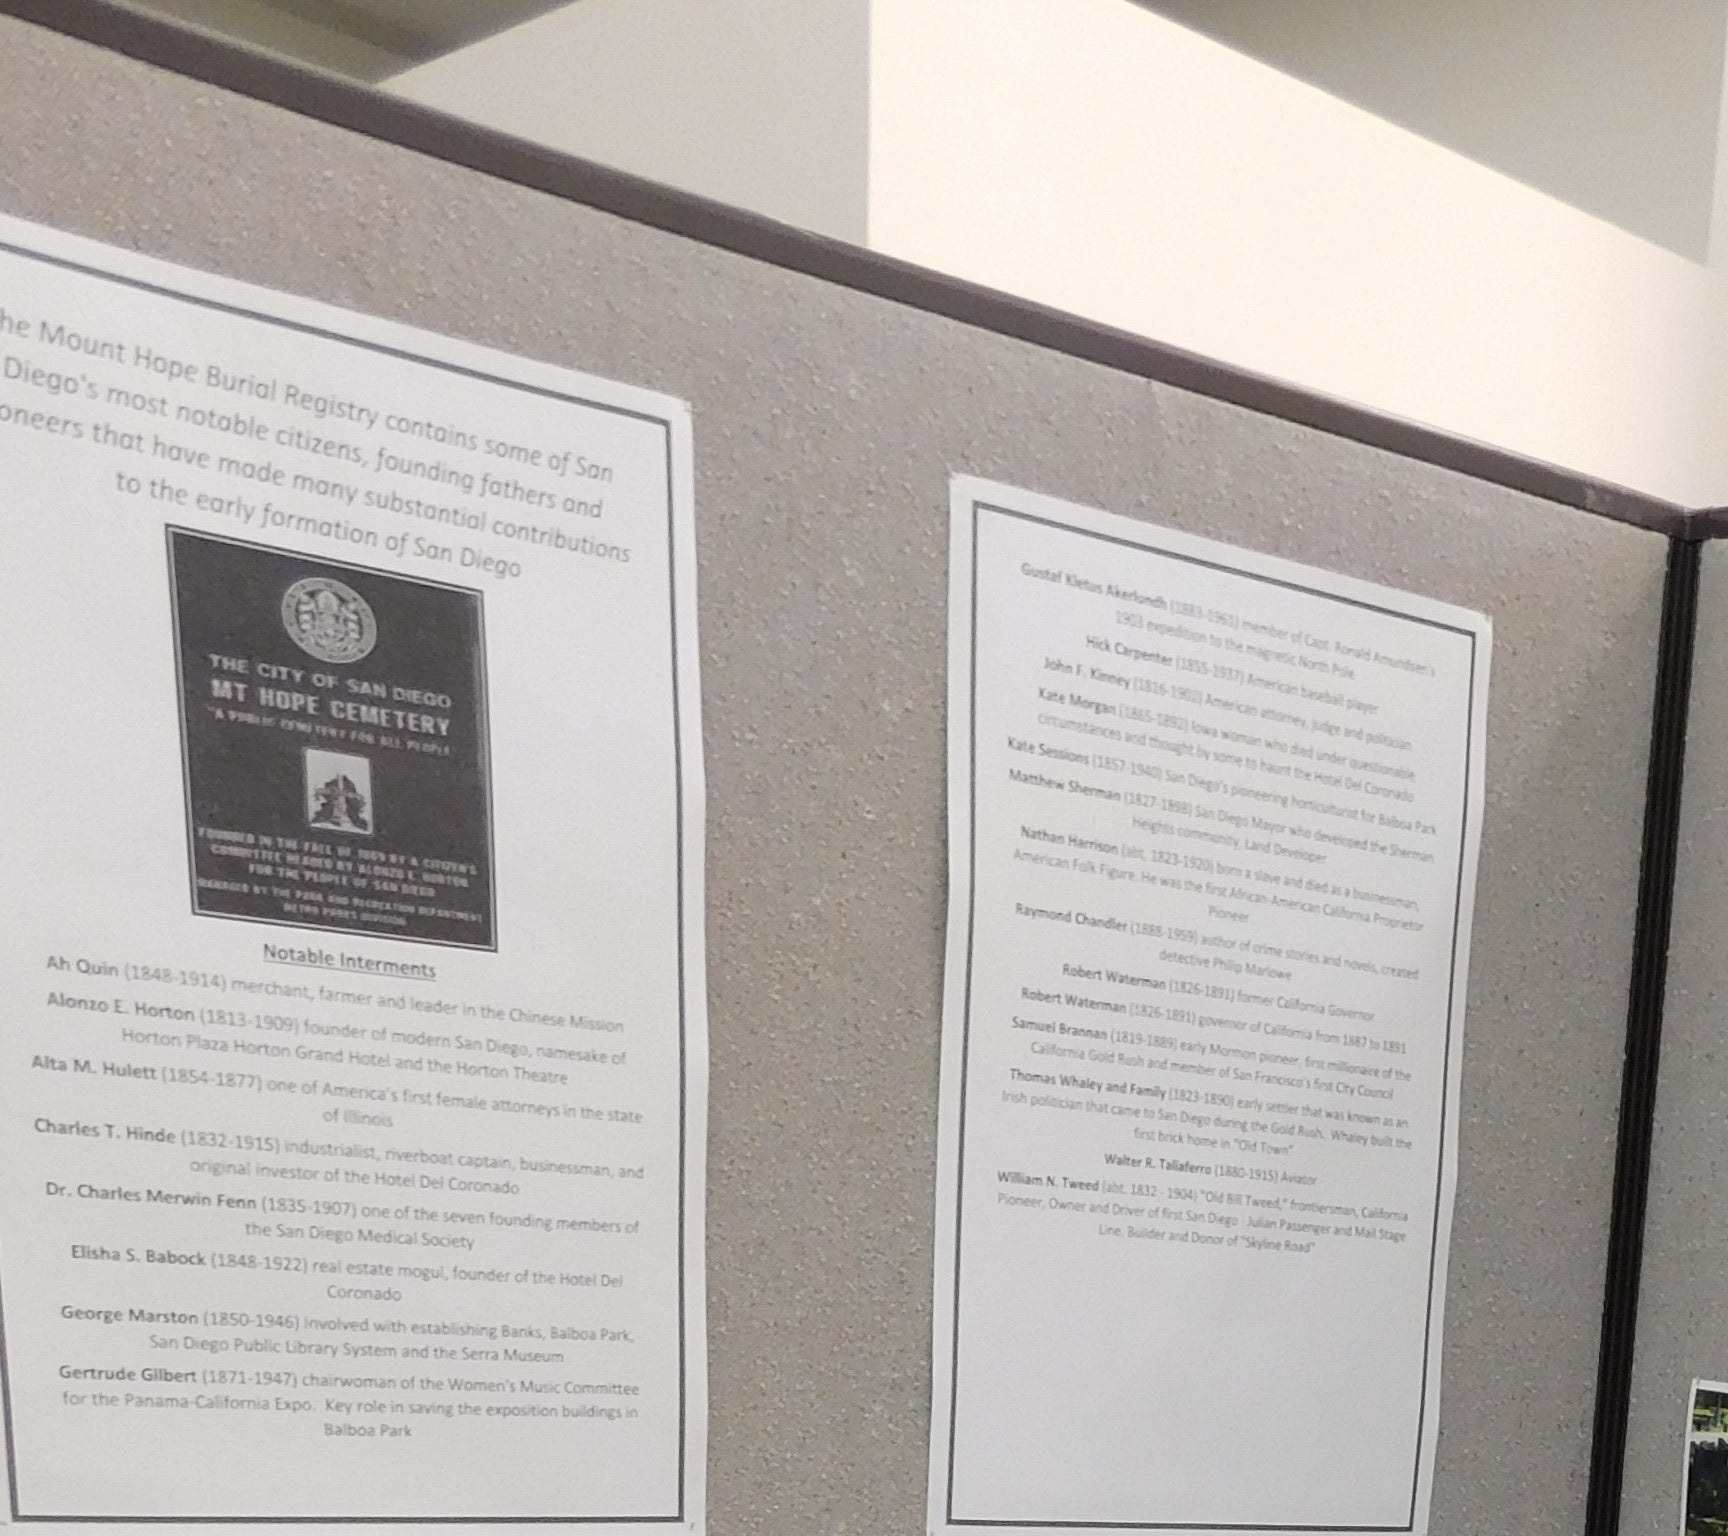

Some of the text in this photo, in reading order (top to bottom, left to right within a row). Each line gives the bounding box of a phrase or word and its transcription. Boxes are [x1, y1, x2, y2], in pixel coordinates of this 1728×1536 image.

[0, 307, 613, 483] he Mount Hope Burial Registry contains some of San
[4, 355, 603, 519] Diego's most notable citizens, founding fathers and
[0, 403, 631, 563] oneers that have made many substantial contributions
[116, 471, 521, 580] to the early formation of San Diego
[208, 653, 452, 709] THE CITY OF SAN DIEGO
[210, 678, 450, 736] MT HOPE CEMETERY
[46, 955, 624, 1033] Ah Quin (1848-1914) merchant, farmer and leader in the Chinese Mission
[263, 944, 438, 981] Notable Interments
[60, 1304, 124, 1325] George
[128, 1308, 199, 1325] Marston
[203, 1310, 300, 1332] (1850-1946)
[304, 1316, 369, 1332] involved
[373, 1320, 407, 1333] with
[410, 1321, 498, 1341] establishing
[501, 1324, 546, 1341] Banks,
[550, 1326, 597, 1341] Balboa
